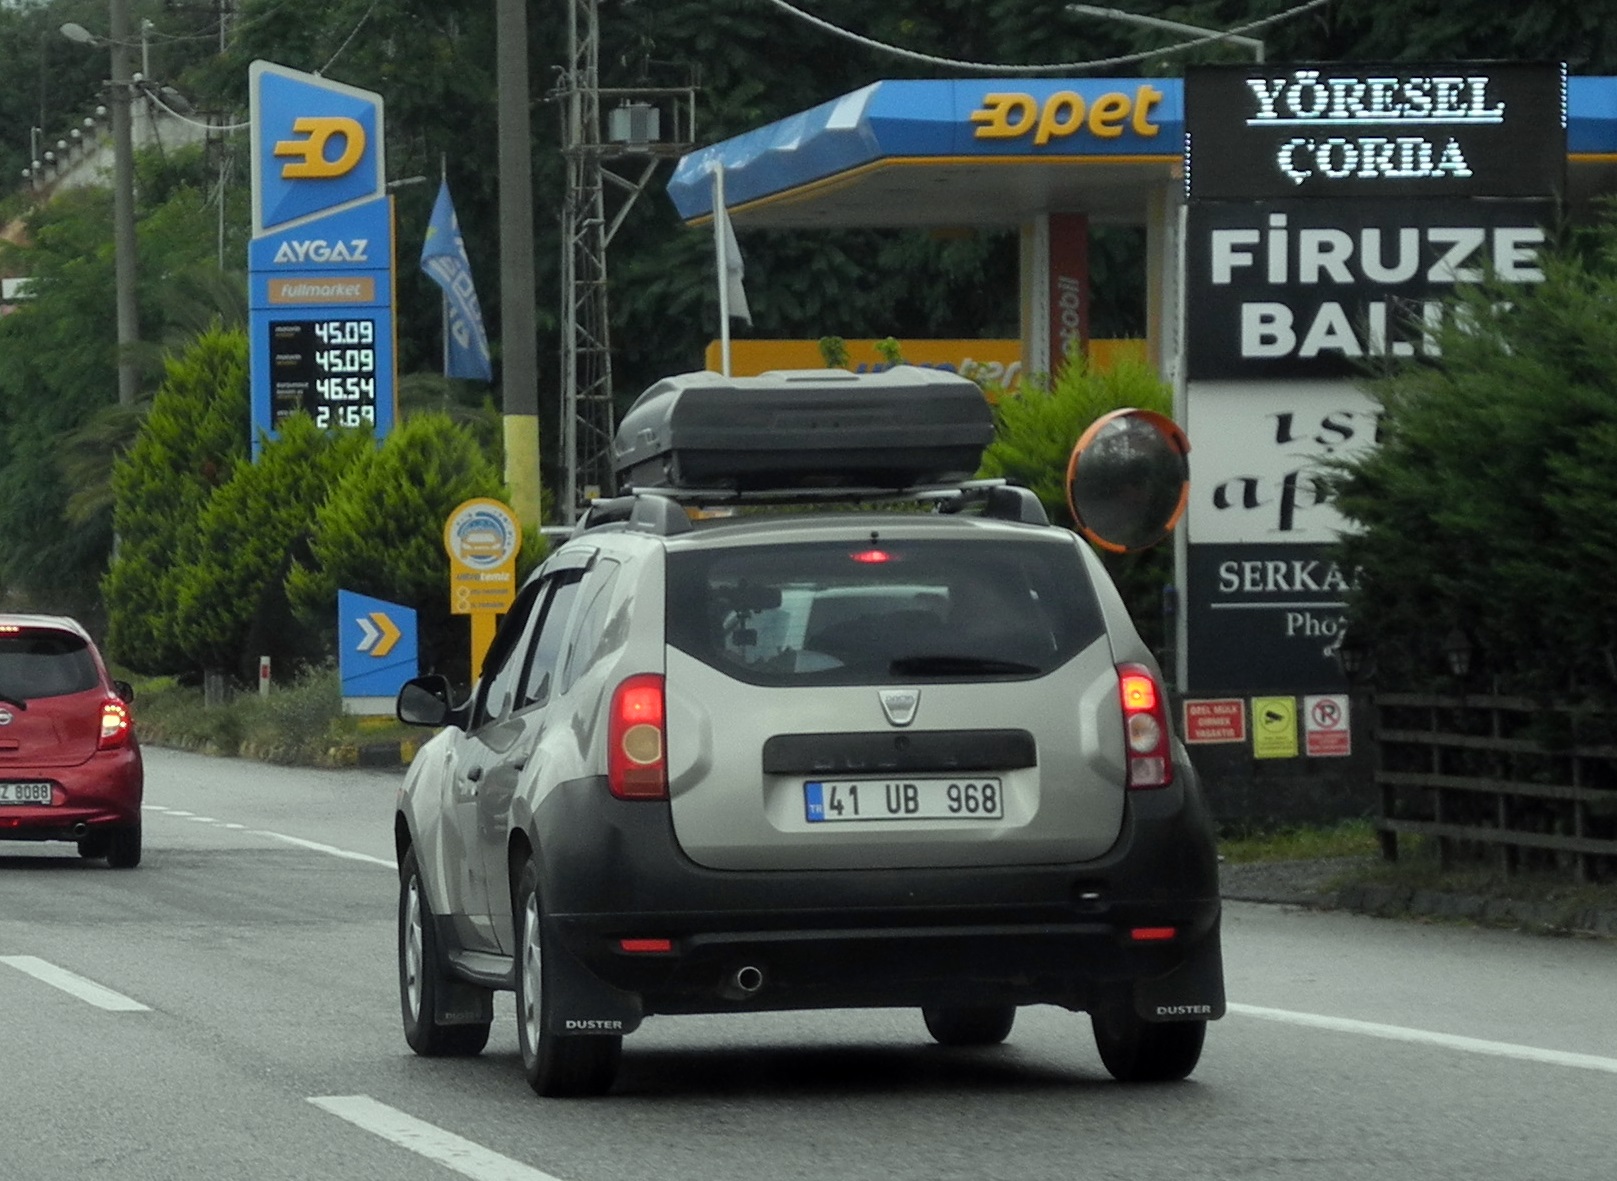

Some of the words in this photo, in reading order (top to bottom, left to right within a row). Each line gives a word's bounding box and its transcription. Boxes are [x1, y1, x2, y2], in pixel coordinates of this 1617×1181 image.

[1246, 71, 1505, 118] YÖRESEL
[969, 85, 1163, 145] opet
[1276, 137, 1473, 185] ÇORBA
[272, 239, 369, 263] AYGAZ
[1211, 213, 1546, 284] FİRUZE
[315, 321, 374, 344] 45.09
[1241, 302, 1516, 358] BALI
[315, 349, 375, 372] 45.09
[316, 377, 375, 400] 46.54
[1286, 612, 1347, 636] Pho
[15, 784, 49, 800] 8088
[829, 785, 860, 816] 41
[885, 784, 919, 814] UB
[946, 783, 997, 814] 968
[809, 804, 823, 814] TR
[1156, 1005, 1212, 1016] DUSTER
[565, 1020, 623, 1030] DUSTER
